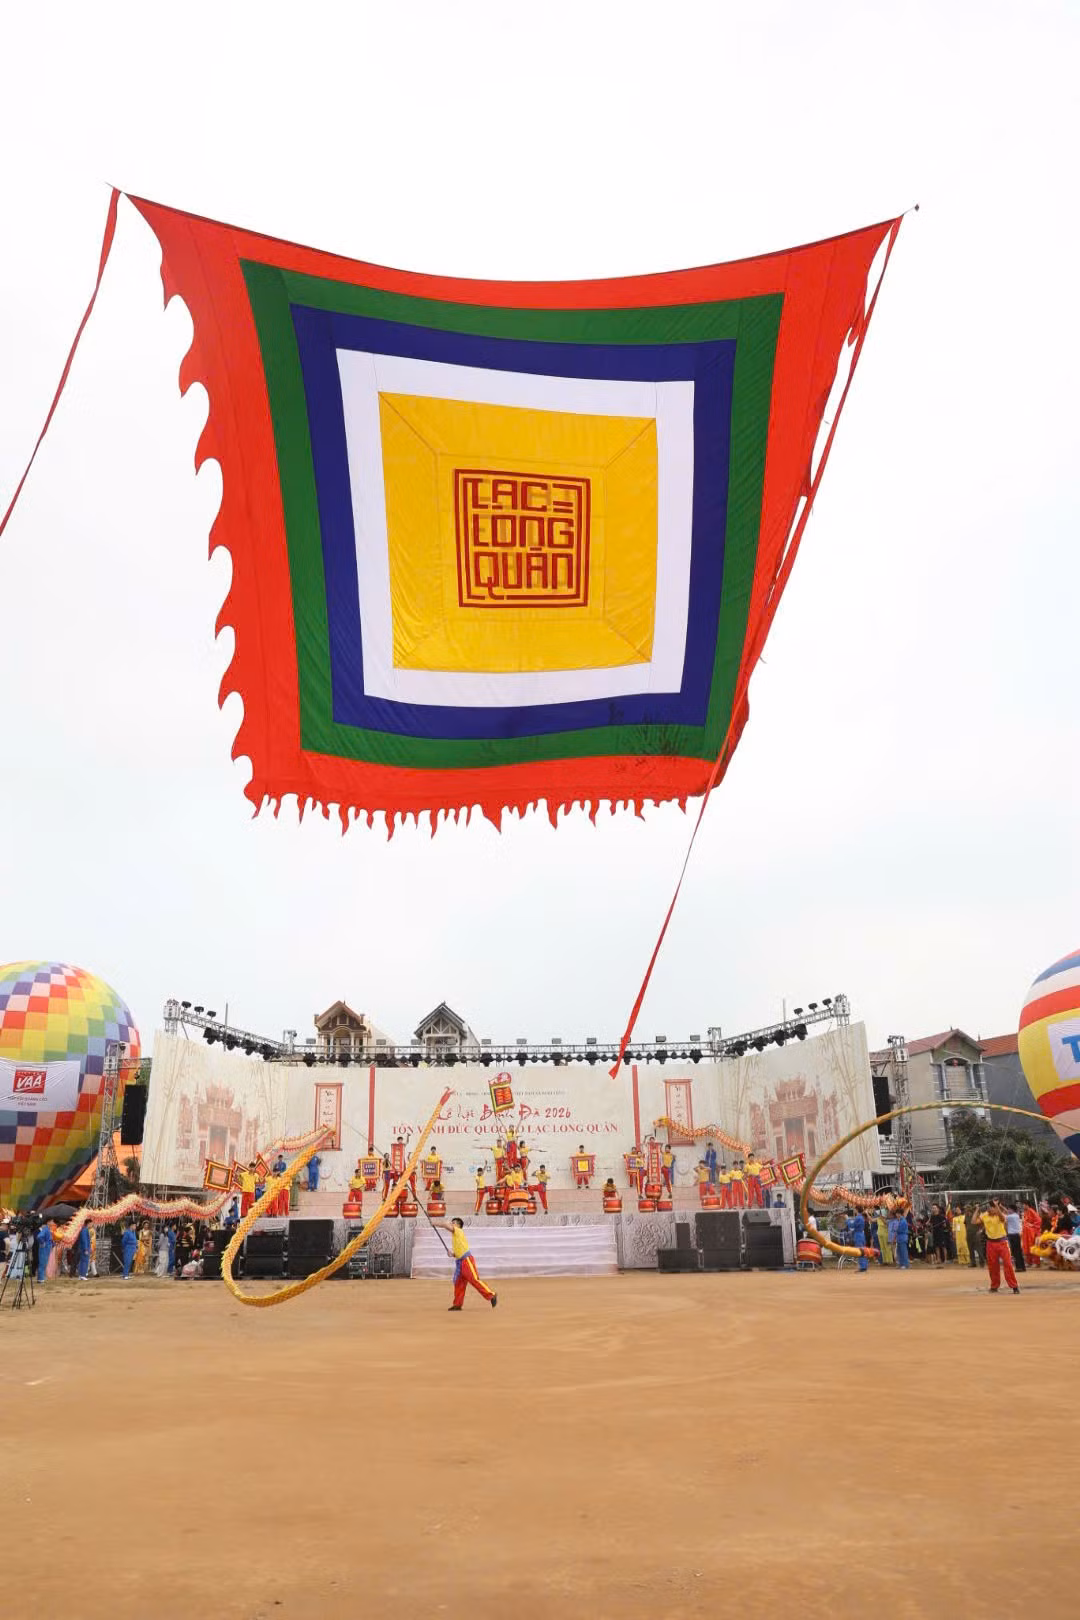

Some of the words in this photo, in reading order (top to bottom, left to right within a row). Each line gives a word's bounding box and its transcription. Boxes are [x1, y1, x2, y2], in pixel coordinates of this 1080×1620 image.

[472, 513, 575, 549] LONG
[16, 1075, 43, 1089] VAA
[545, 1107, 571, 1119] 2026
[416, 1125, 445, 1135] VNH
[527, 1123, 550, 1136] LẠC
[553, 1123, 584, 1134] LONG
[586, 1121, 619, 1136] QUÂN
